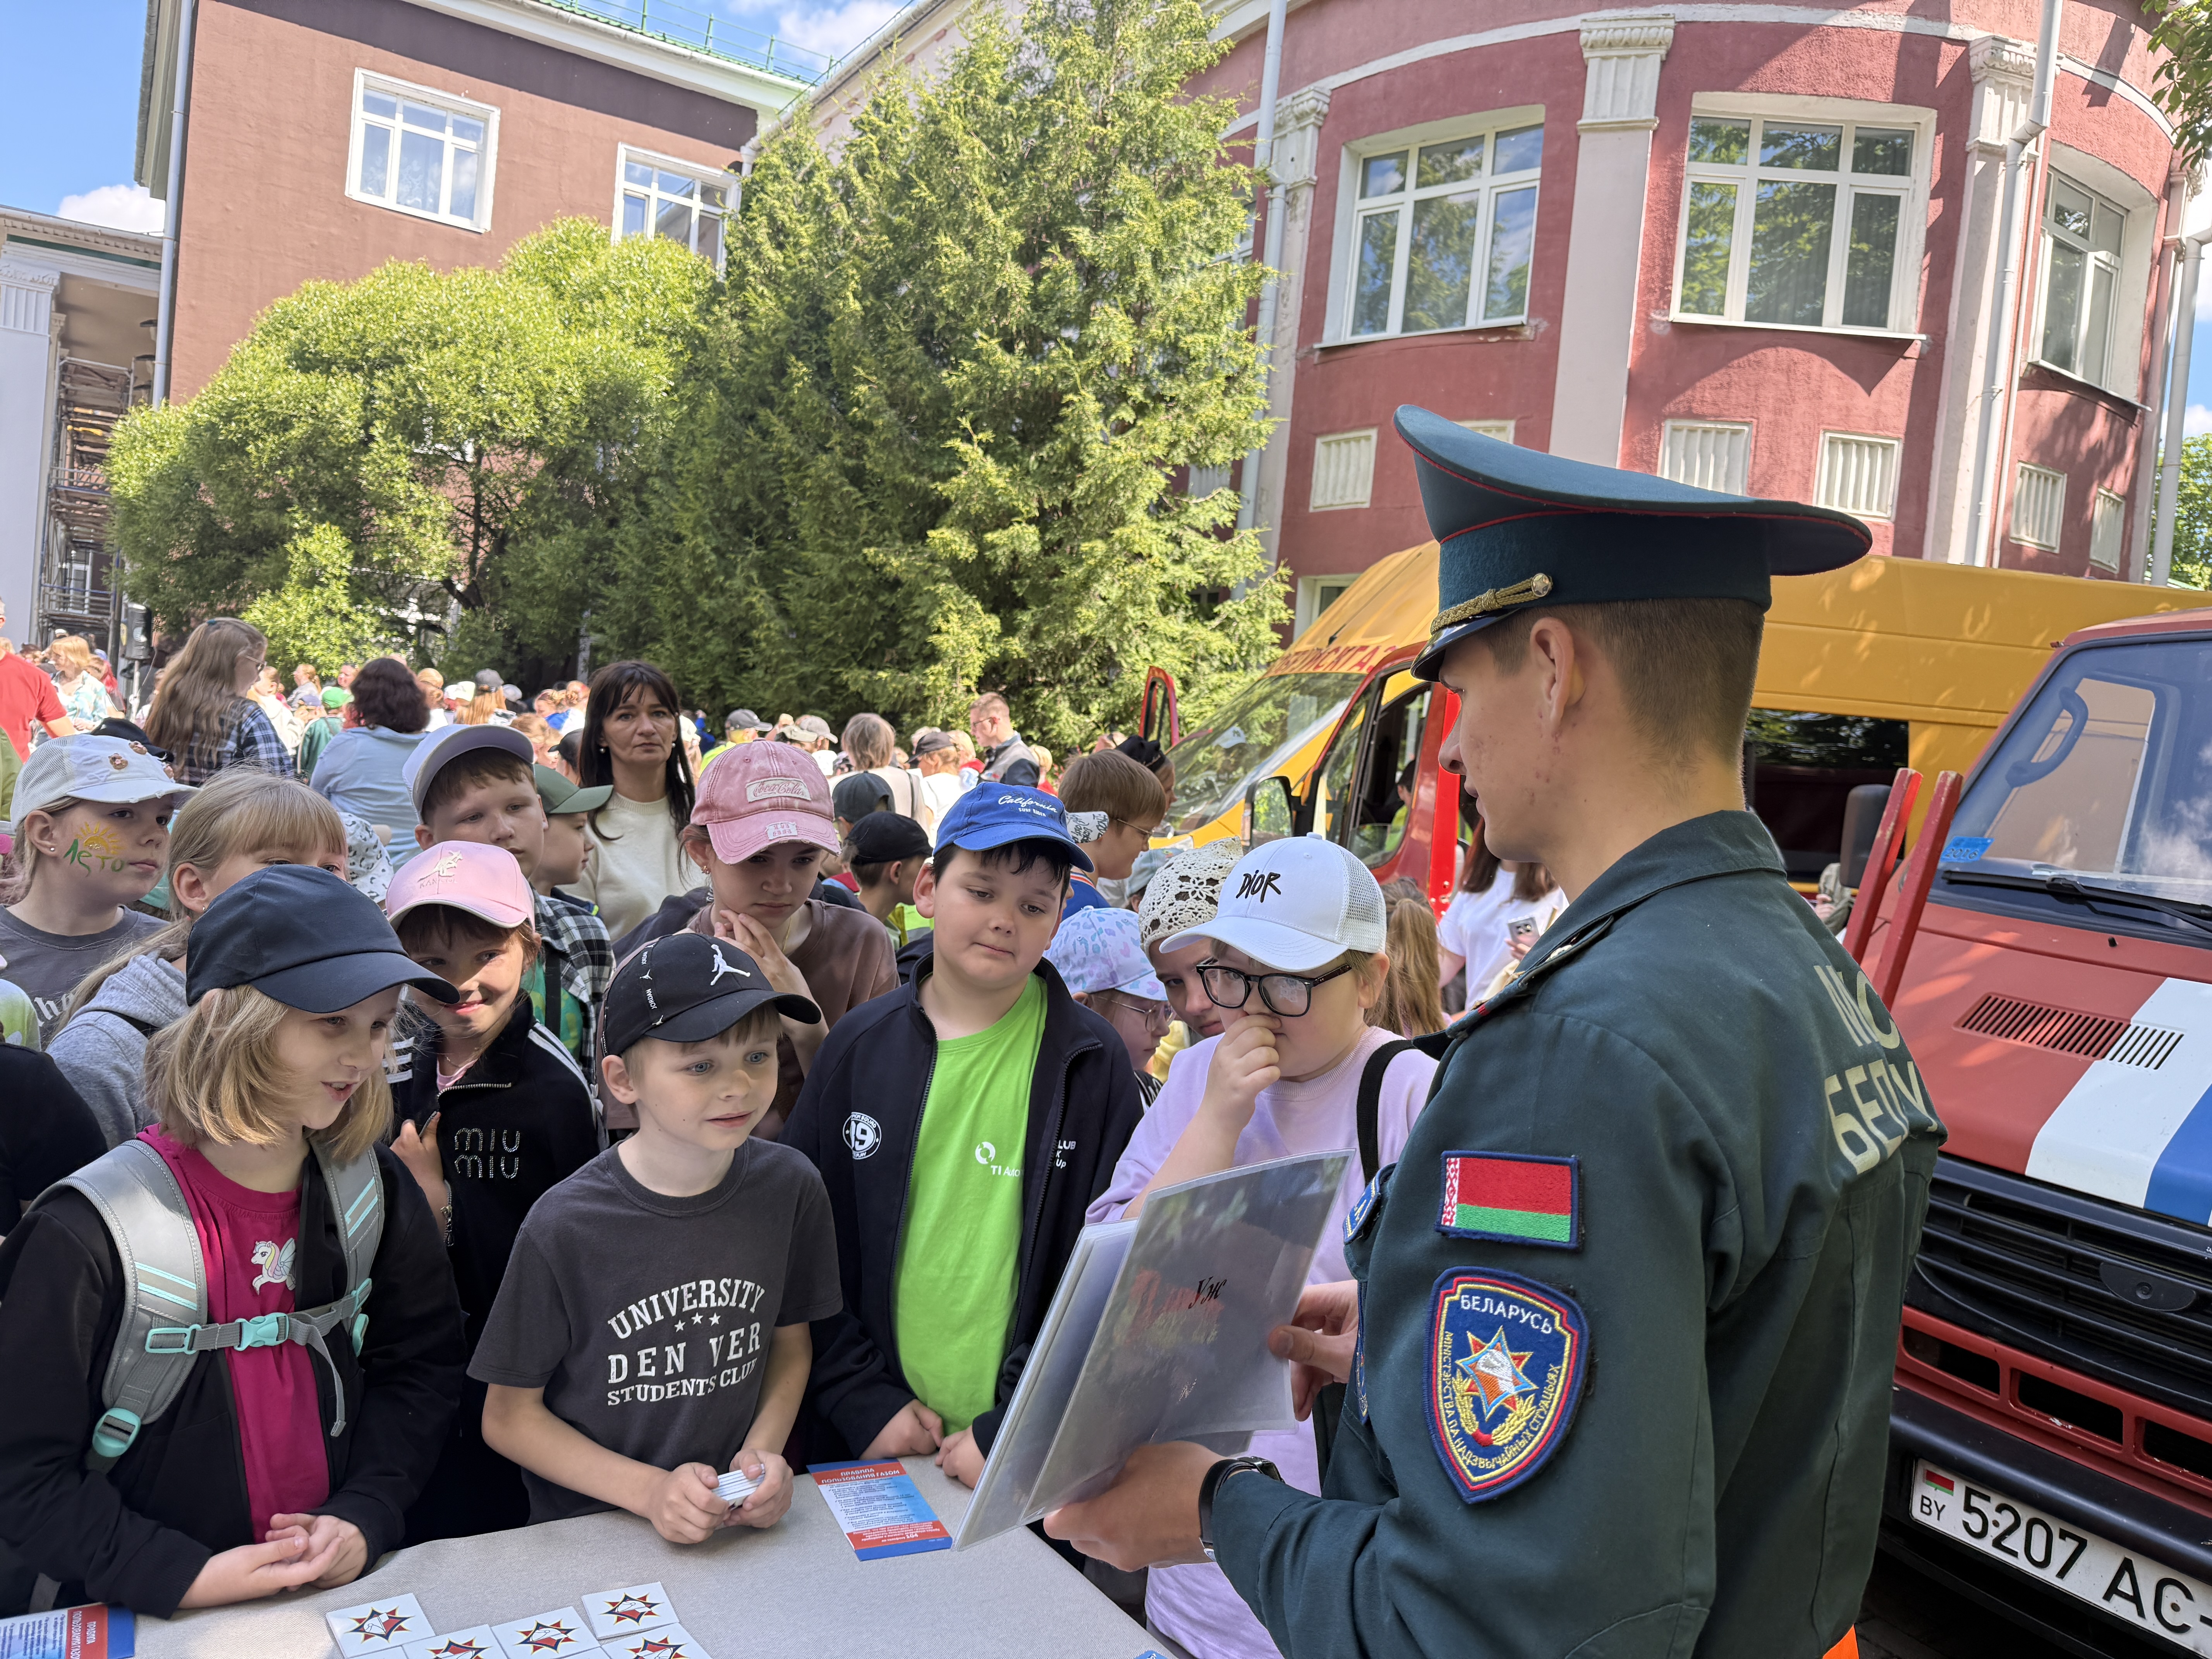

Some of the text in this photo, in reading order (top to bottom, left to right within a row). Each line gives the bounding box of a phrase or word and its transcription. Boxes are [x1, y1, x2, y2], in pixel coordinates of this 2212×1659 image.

[998, 795, 1058, 813] California
[1032, 809, 1046, 817] RIDER
[1945, 847, 1979, 860] 2016
[646, 988, 658, 1010] JORDAN
[1058, 1140, 1076, 1150] LUB
[991, 1165, 1022, 1177] TI Auto
[608, 1278, 765, 1339] UNIVERSITY
[1461, 1295, 1553, 1334] БЕЛАРУСЬ
[608, 1358, 757, 1406] STUDENTS CLUB
[1443, 1331, 1455, 1419] МІНІСТЭРСТВА
[1449, 1422, 1460, 1437] ПА
[1454, 1433, 1534, 1470] НАДЗВЫЧАЙНЫХ
[821, 1473, 875, 1484] ПОЛЬЗОВАНИЯ
[841, 1468, 874, 1477] ПРАВИЛА
[1920, 1494, 1946, 1521] BY
[1961, 1486, 2088, 1580] 5207
[86, 1621, 96, 1645] ПРАВИЛА
[70, 1645, 81, 1659] ГАЗО
